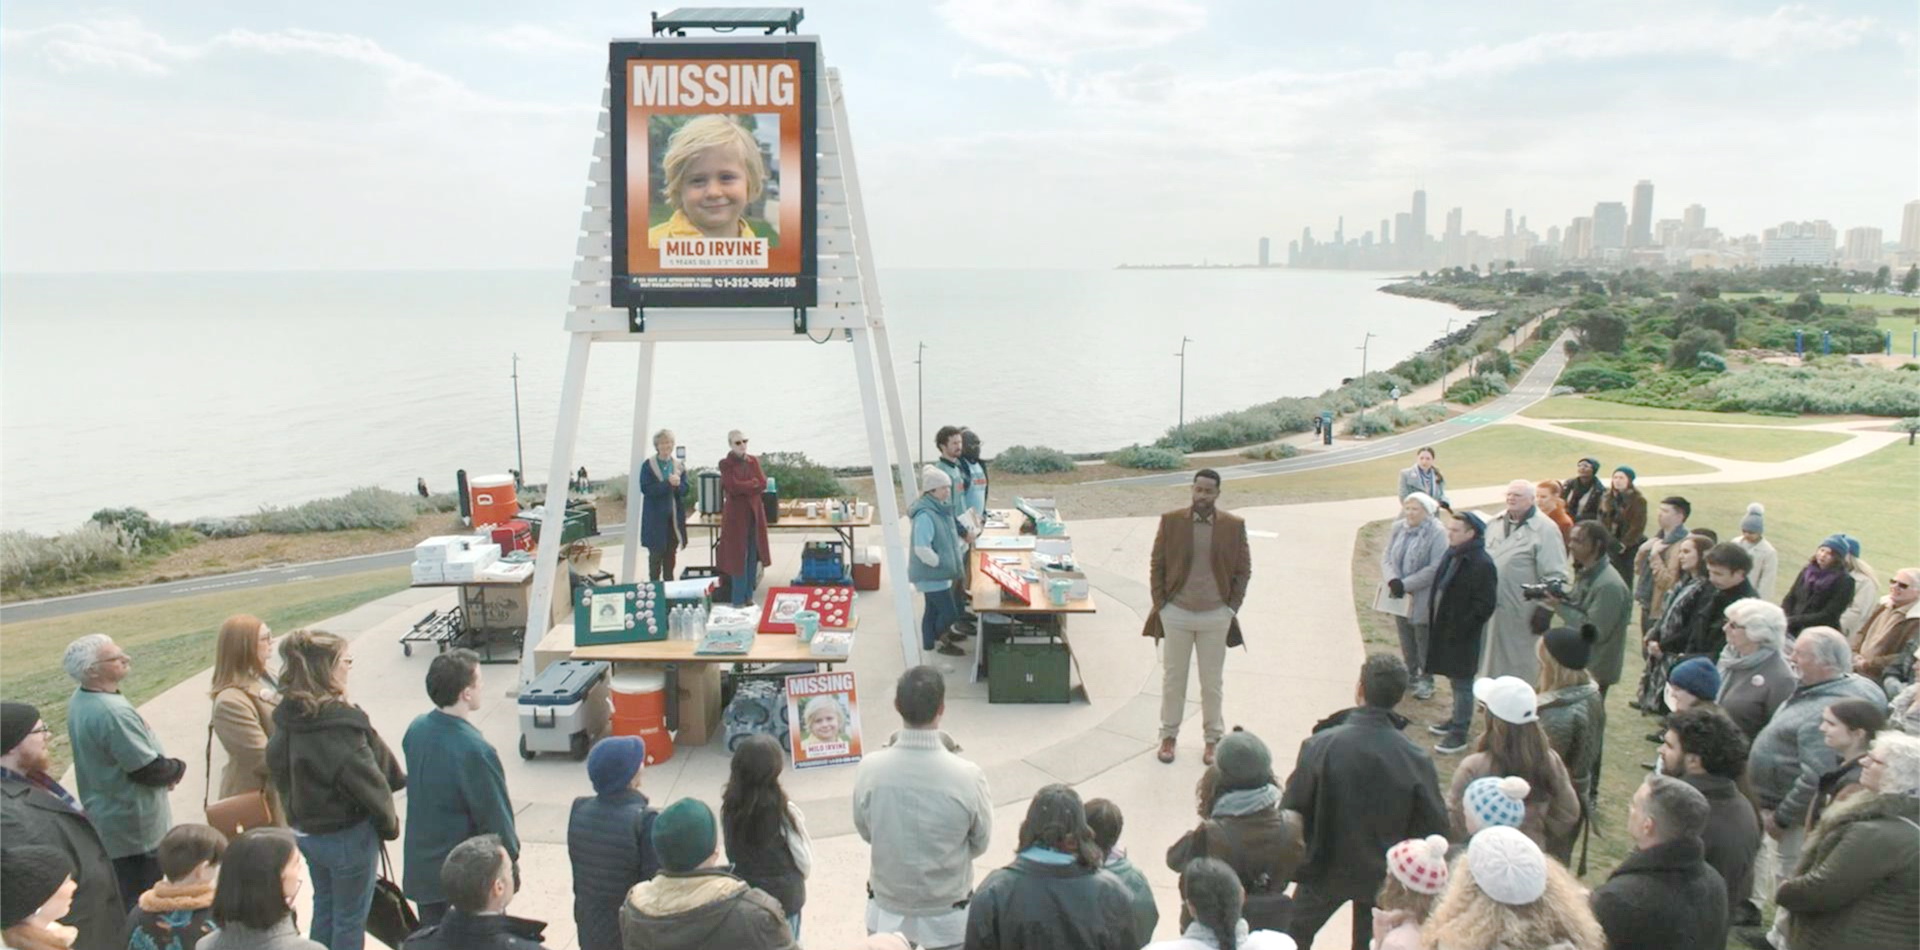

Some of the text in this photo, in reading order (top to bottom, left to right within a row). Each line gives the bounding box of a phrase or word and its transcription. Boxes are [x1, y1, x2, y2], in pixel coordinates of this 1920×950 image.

[633, 64, 794, 107] MISSING
[666, 241, 762, 256] MILO IRVINE
[789, 673, 854, 695] MISSING
[808, 743, 847, 753] MILO IRVINE
